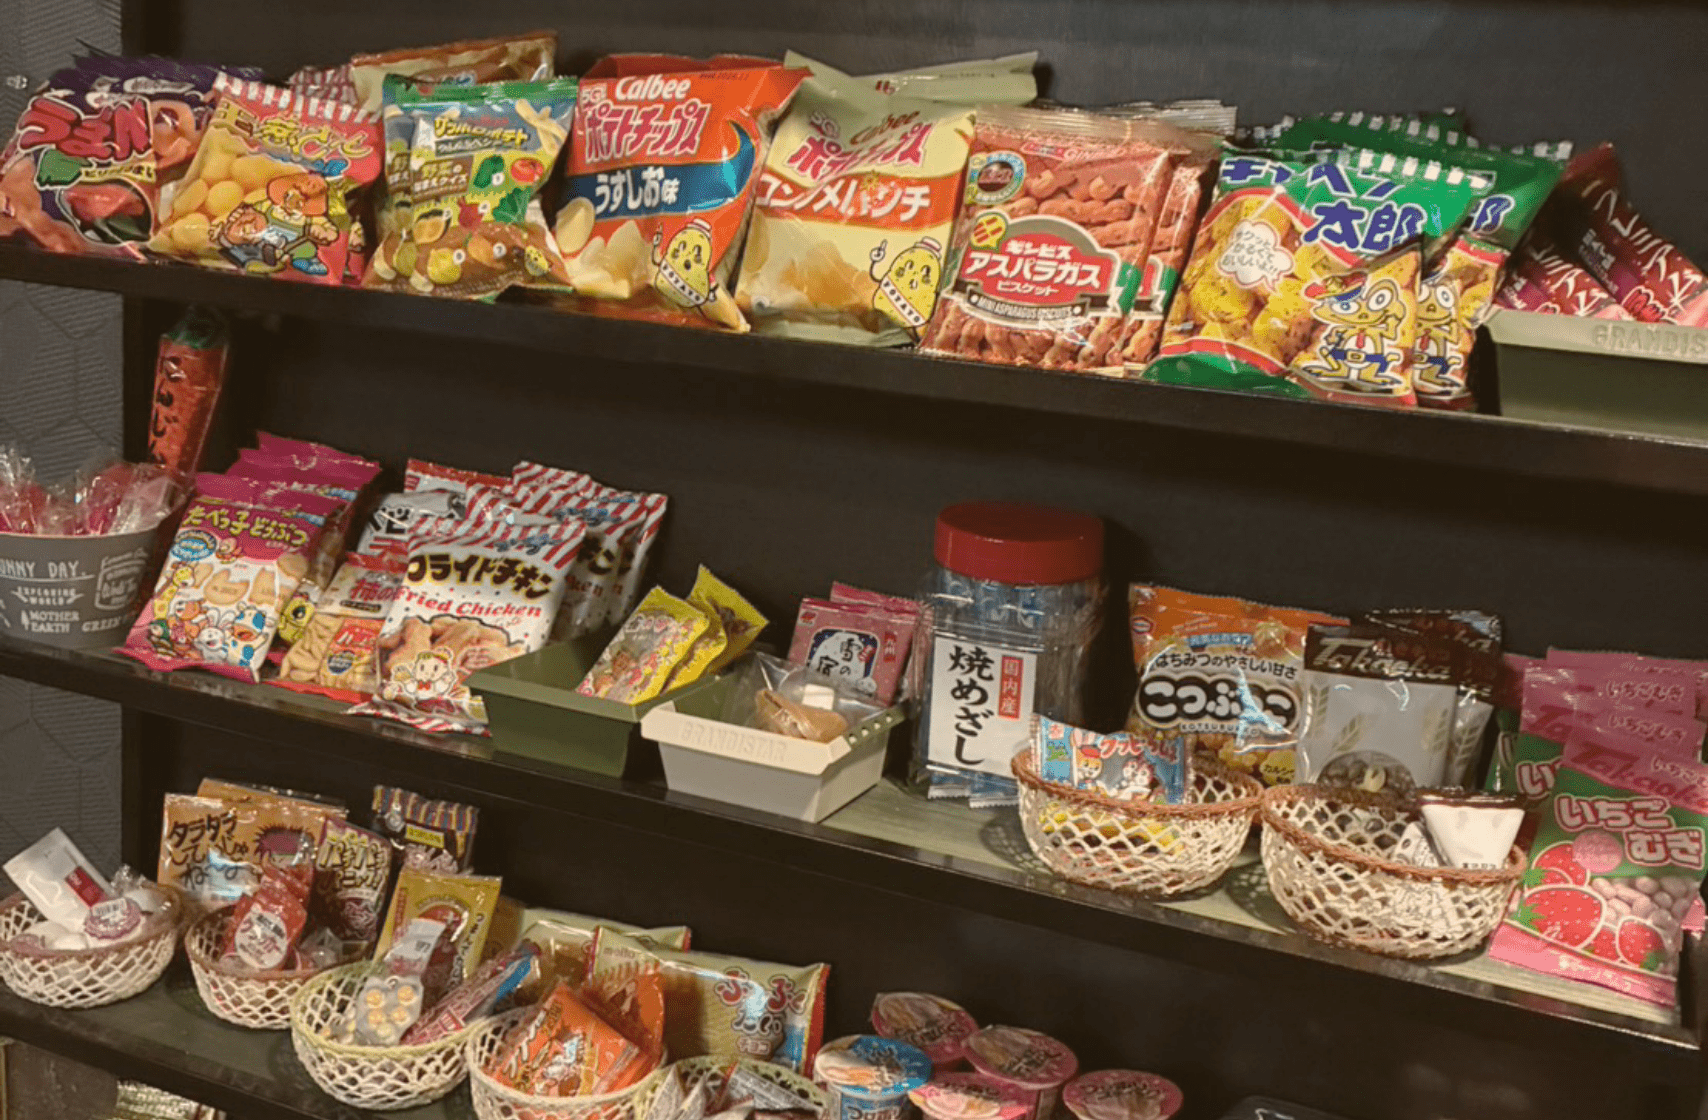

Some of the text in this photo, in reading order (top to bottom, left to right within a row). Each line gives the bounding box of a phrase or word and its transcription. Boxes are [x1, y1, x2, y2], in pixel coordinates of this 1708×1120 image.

[615, 74, 692, 101] Calbee
[586, 99, 712, 164] ポテトチップス
[594, 166, 681, 215] うすしお味
[1302, 199, 1427, 252] 太郎
[1004, 239, 1074, 260] ギンビス
[964, 251, 1101, 289] アスパラガス
[996, 280, 1059, 296] ビスケット
[881, 279, 928, 325] POTATO
[181, 505, 311, 546] たべっ子どうぶつ
[29, 610, 80, 623] MOTHER
[31, 622, 71, 634] EARTH
[455, 601, 543, 618] Chicken
[1154, 652, 1298, 681] はちみつのやさしい甘さ
[948, 645, 995, 766] 焼めざし
[1140, 677, 1293, 729] こつぶこ
[168, 808, 238, 849] タラタラ
[1555, 793, 1673, 831] いちご
[1626, 828, 1704, 868] むぎ
